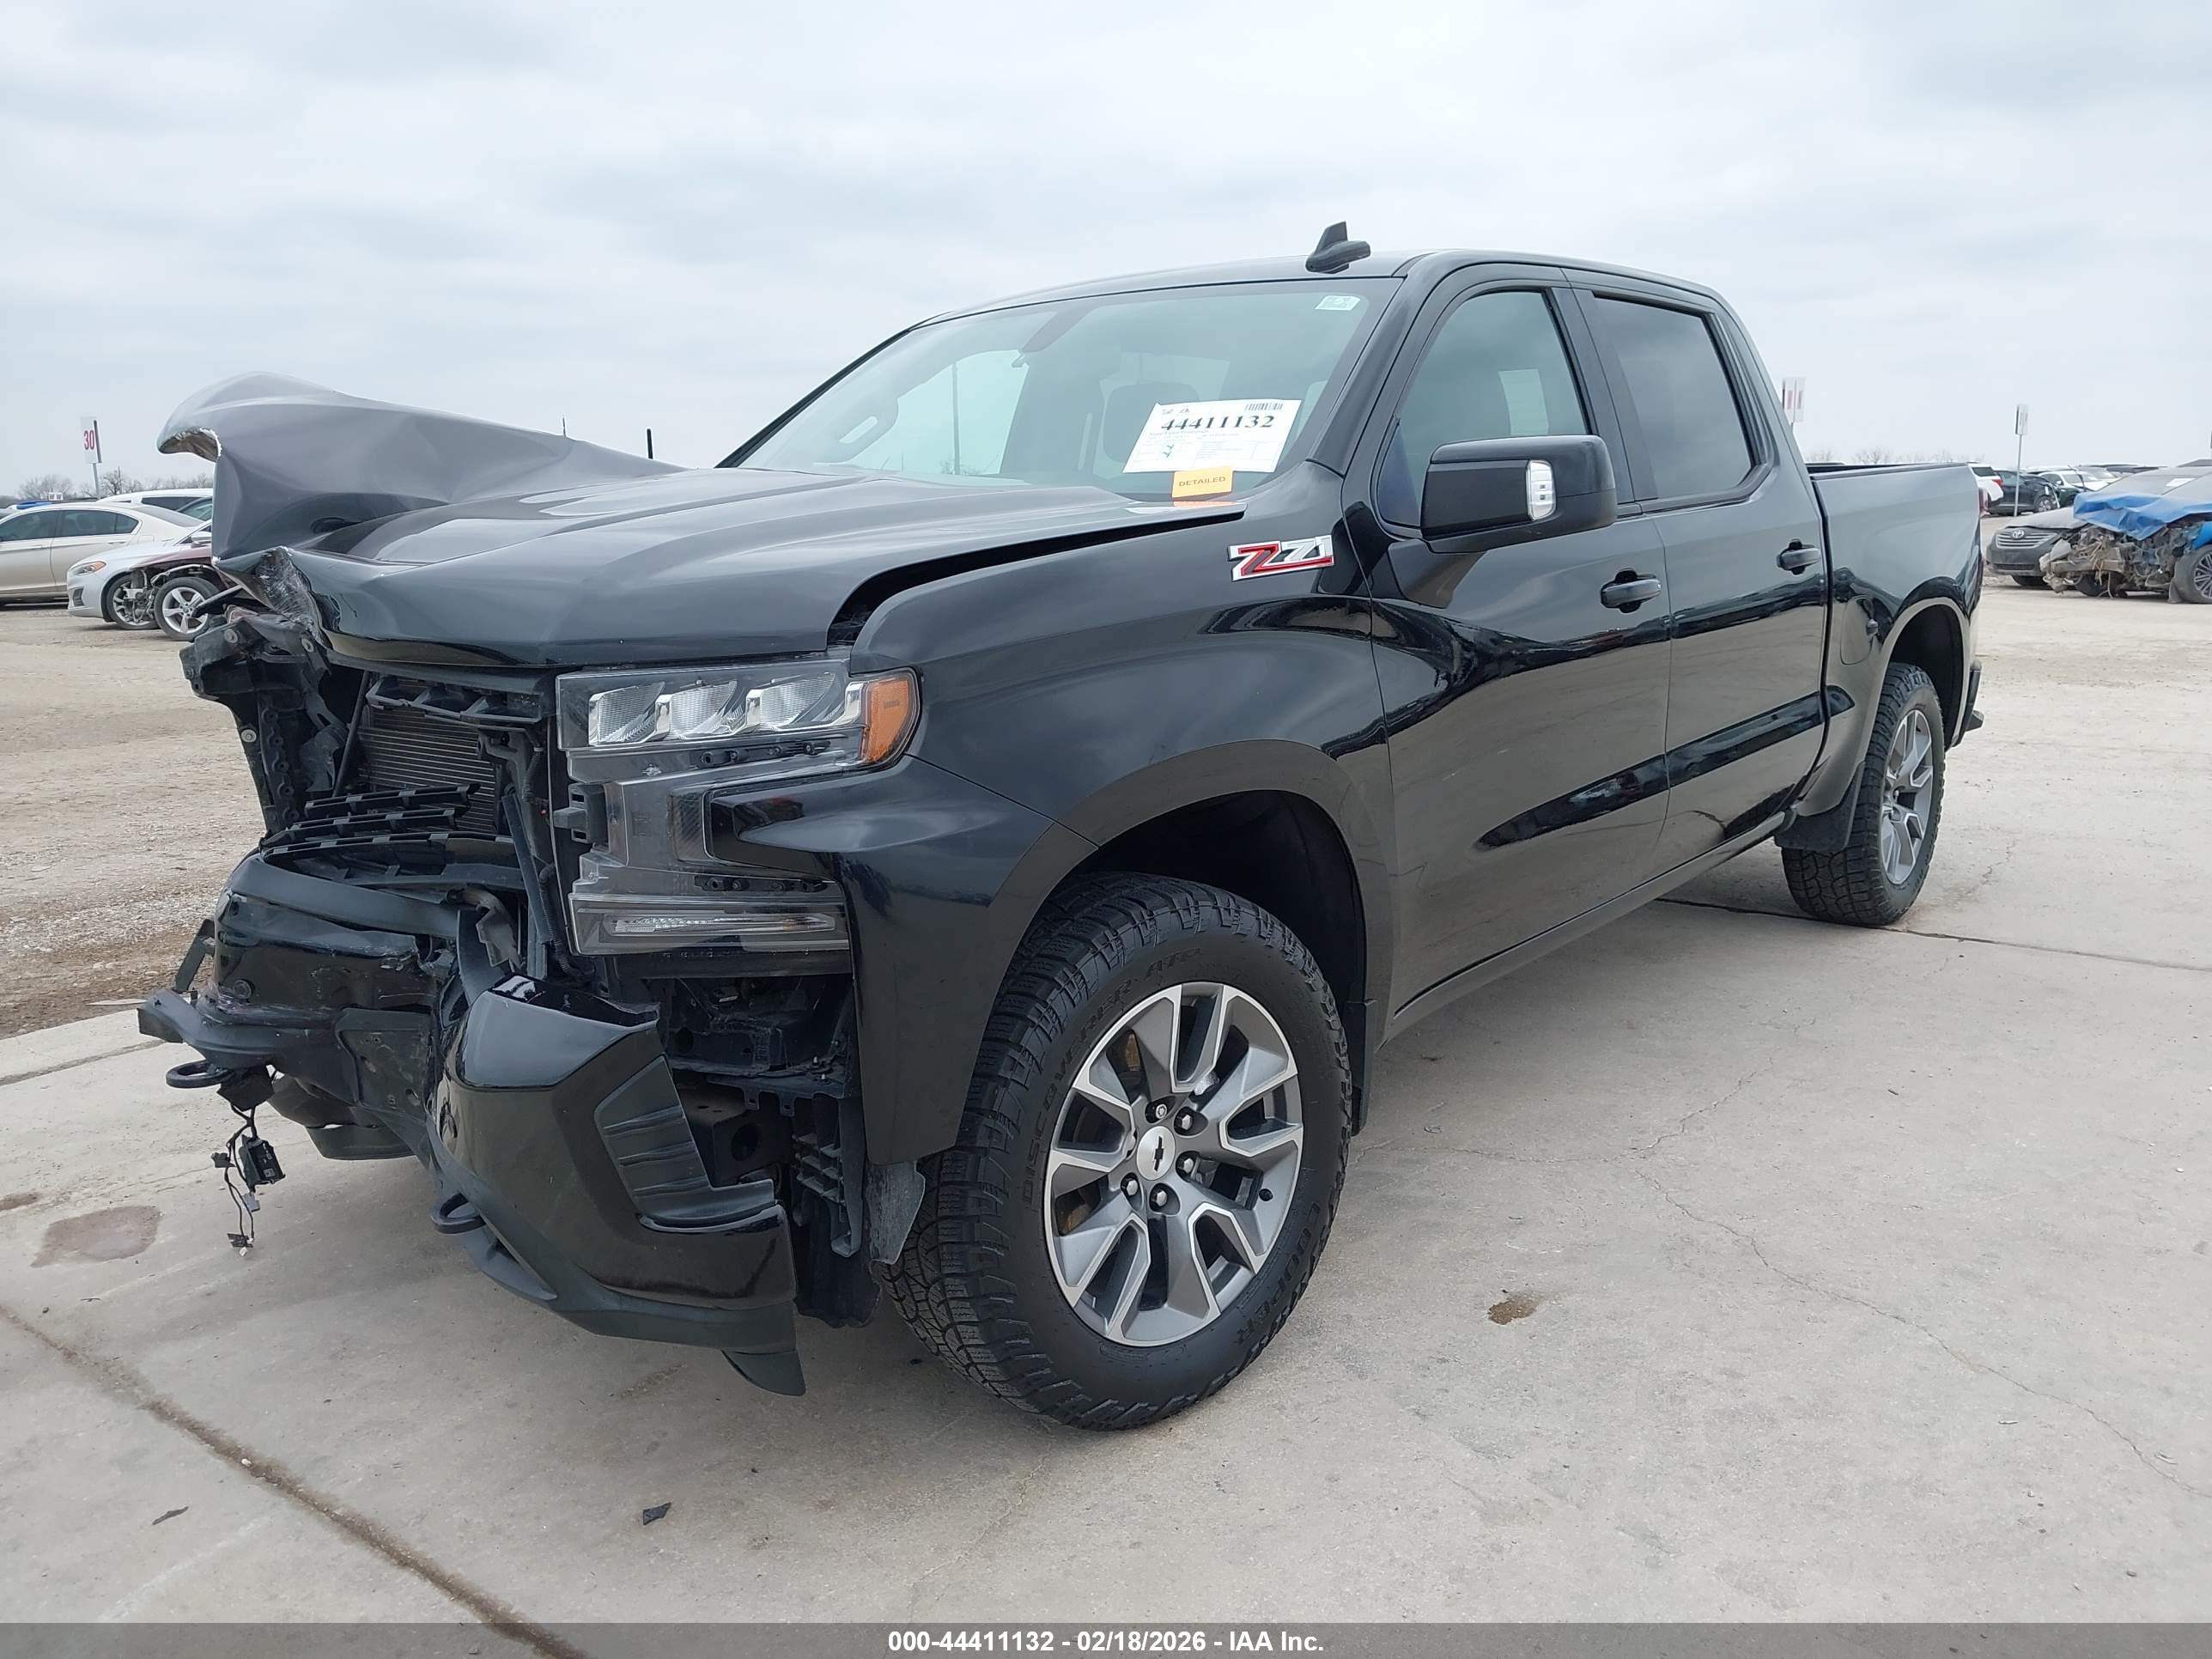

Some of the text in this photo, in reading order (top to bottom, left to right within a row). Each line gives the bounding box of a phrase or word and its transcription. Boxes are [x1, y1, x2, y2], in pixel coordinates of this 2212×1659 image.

[1160, 415, 1274, 430] 44411132
[83, 430, 95, 450] 30
[1178, 476, 1226, 487] DETAILED
[1227, 534, 1334, 582] Z71
